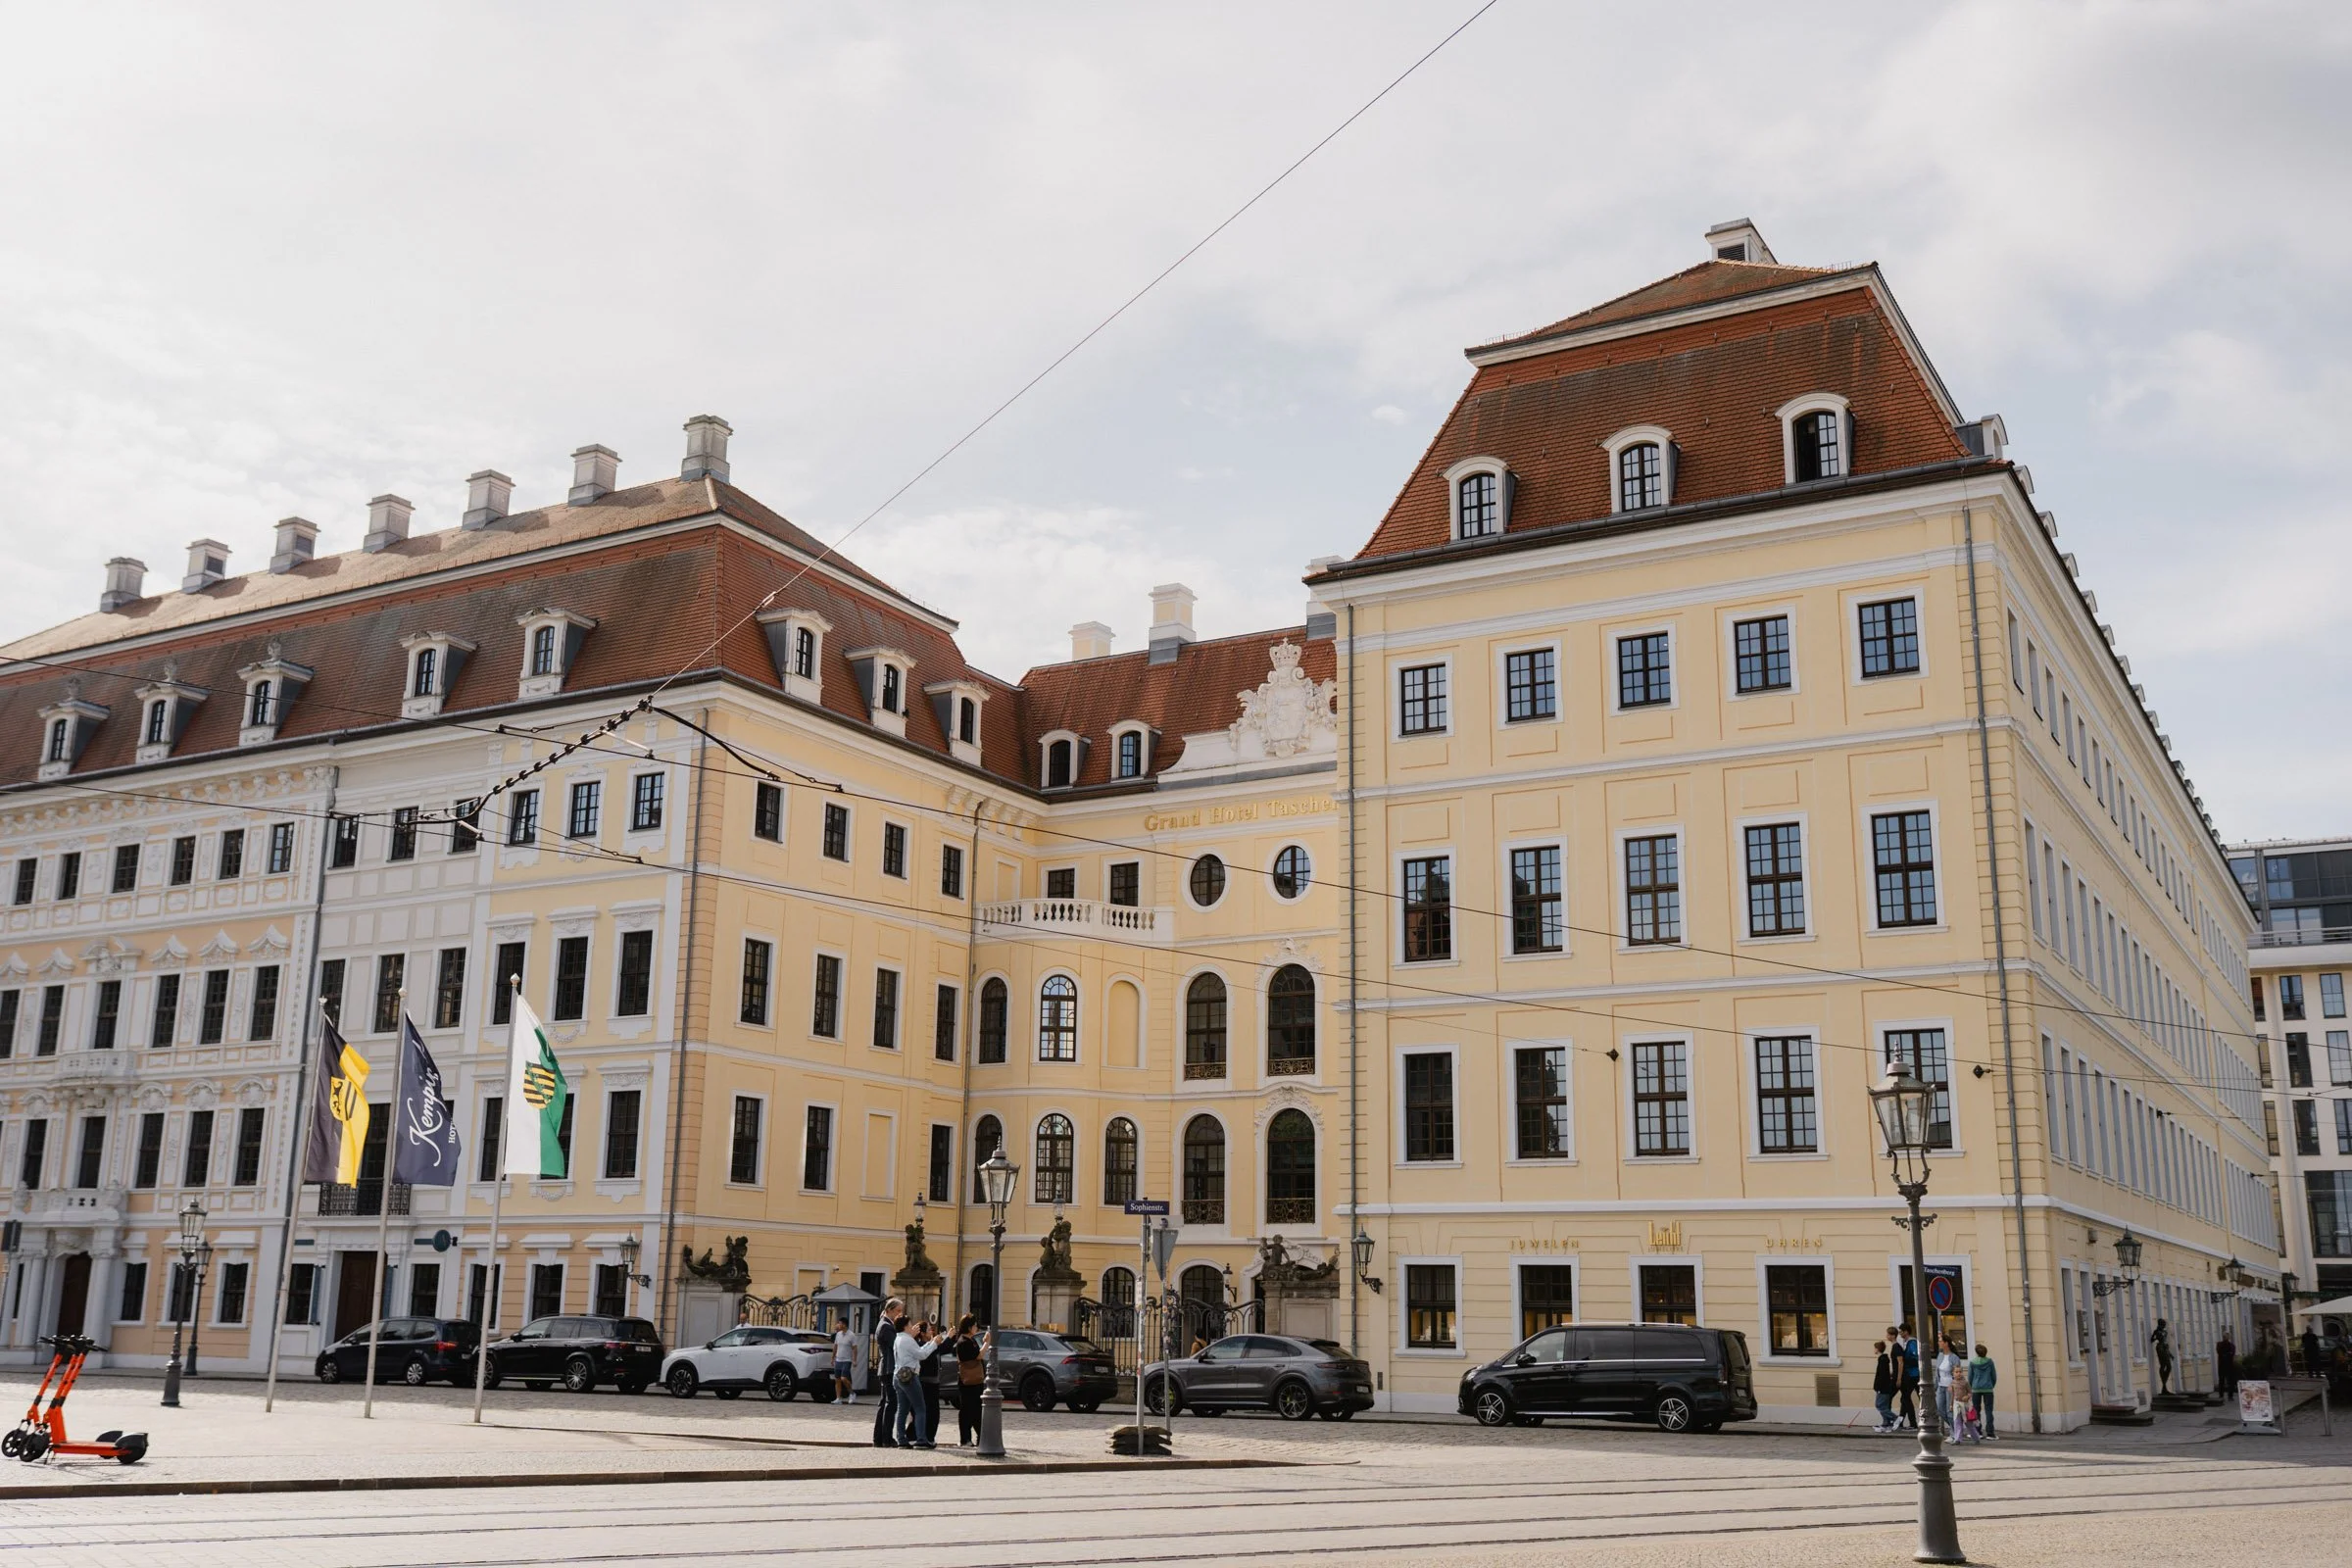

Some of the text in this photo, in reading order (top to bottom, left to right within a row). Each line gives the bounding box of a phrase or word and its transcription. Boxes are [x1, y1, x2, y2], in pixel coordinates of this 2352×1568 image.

[1144, 808, 1201, 831] Grand
[1208, 801, 1258, 824] Hotel
[1130, 1202, 1164, 1212] Sophienstr.
[1510, 1238, 1579, 1250] JUWELEN
[1765, 1238, 1822, 1248] UHREN
